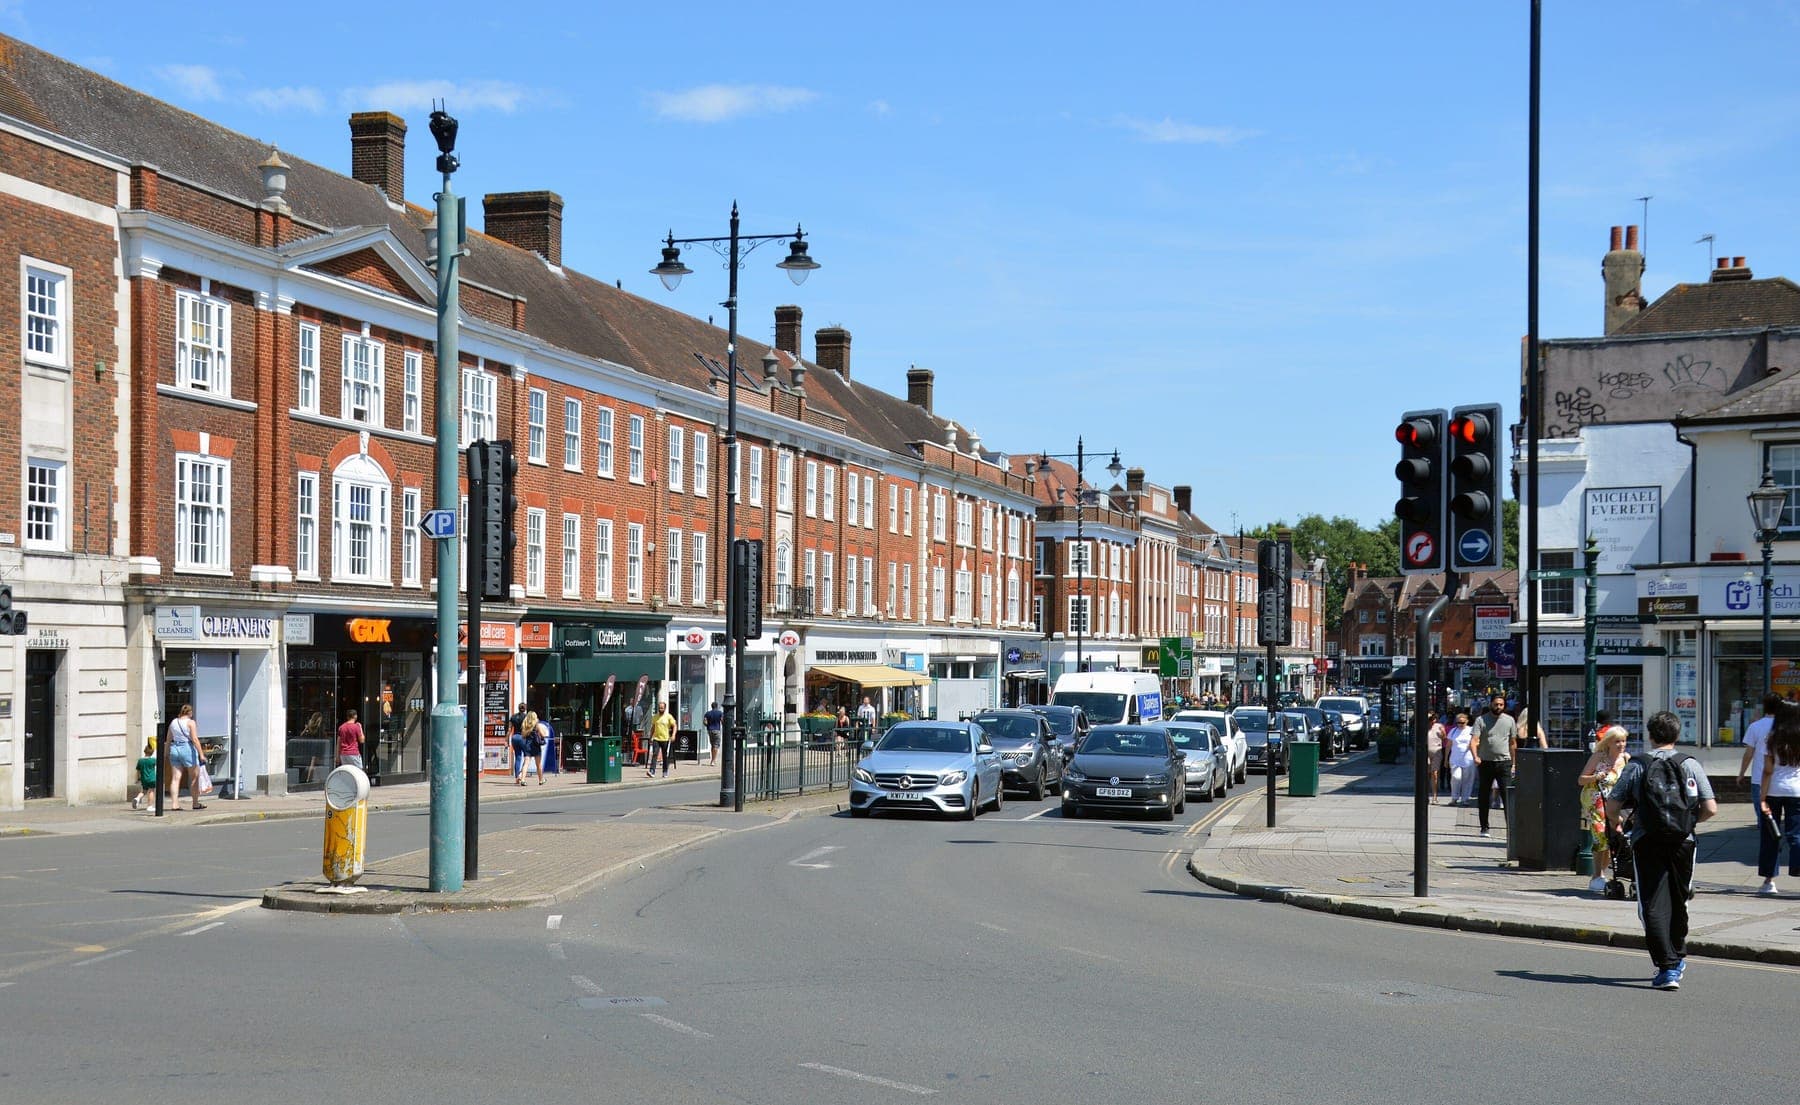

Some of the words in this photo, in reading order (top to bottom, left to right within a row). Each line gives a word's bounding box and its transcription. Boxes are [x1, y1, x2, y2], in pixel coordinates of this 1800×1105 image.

[1592, 492, 1657, 503] MICHAEL
[1591, 504, 1656, 515] EVERETT
[438, 514, 452, 534] P
[1755, 584, 1793, 597] Tch
[202, 616, 271, 638] CLEANERS
[351, 618, 392, 643] GDK
[1537, 640, 1579, 648] ICHAEL
[886, 649, 898, 658] W
